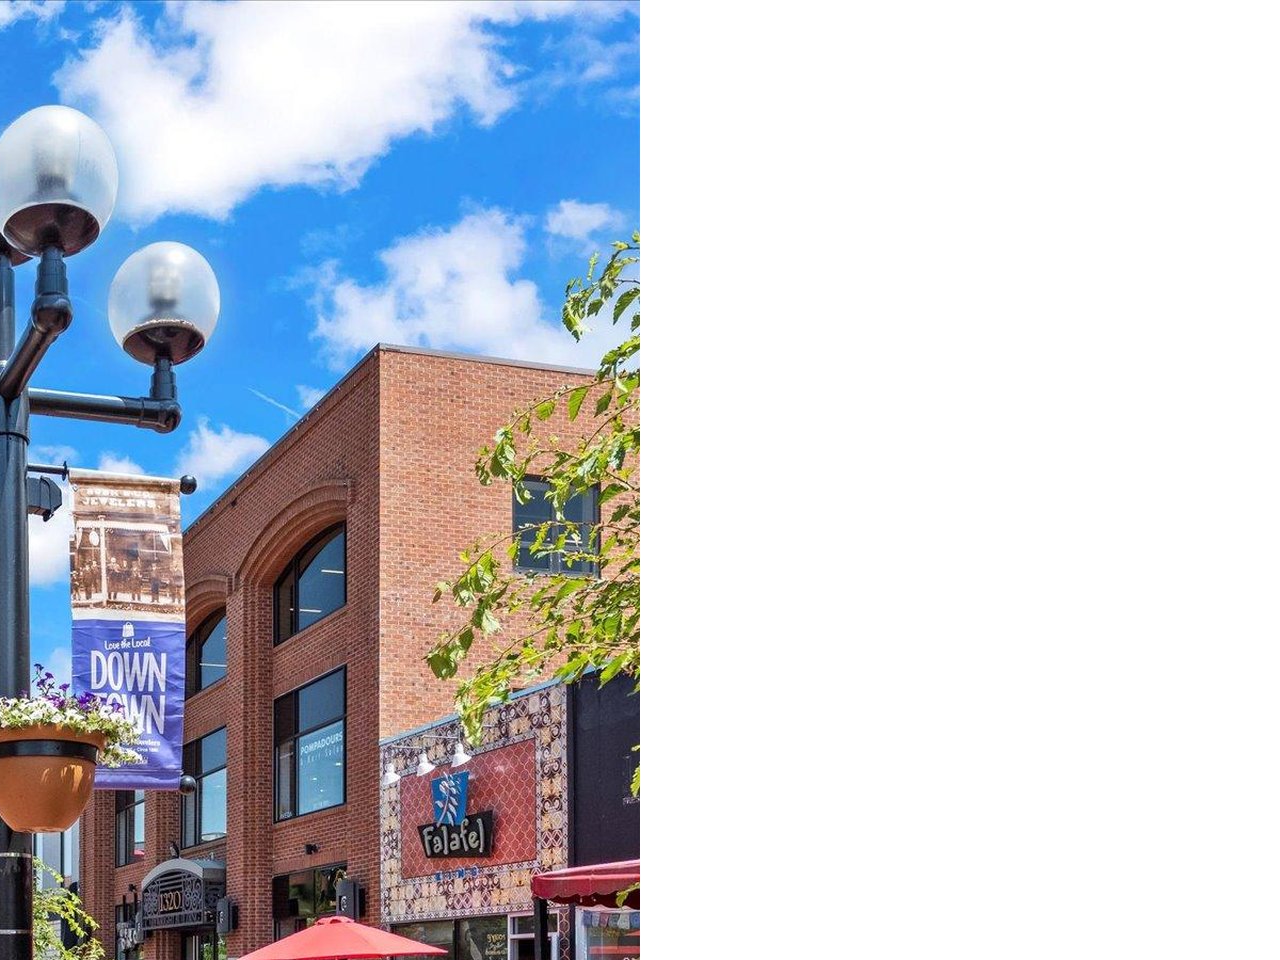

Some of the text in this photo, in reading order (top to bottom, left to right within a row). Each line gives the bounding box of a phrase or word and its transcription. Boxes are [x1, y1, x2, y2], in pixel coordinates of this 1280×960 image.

[104, 636, 151, 651] Love the Local
[90, 650, 166, 693] DOWN
[300, 731, 343, 756] POMPADOURS
[422, 817, 485, 857] Falafel
[160, 890, 181, 912] 1320
